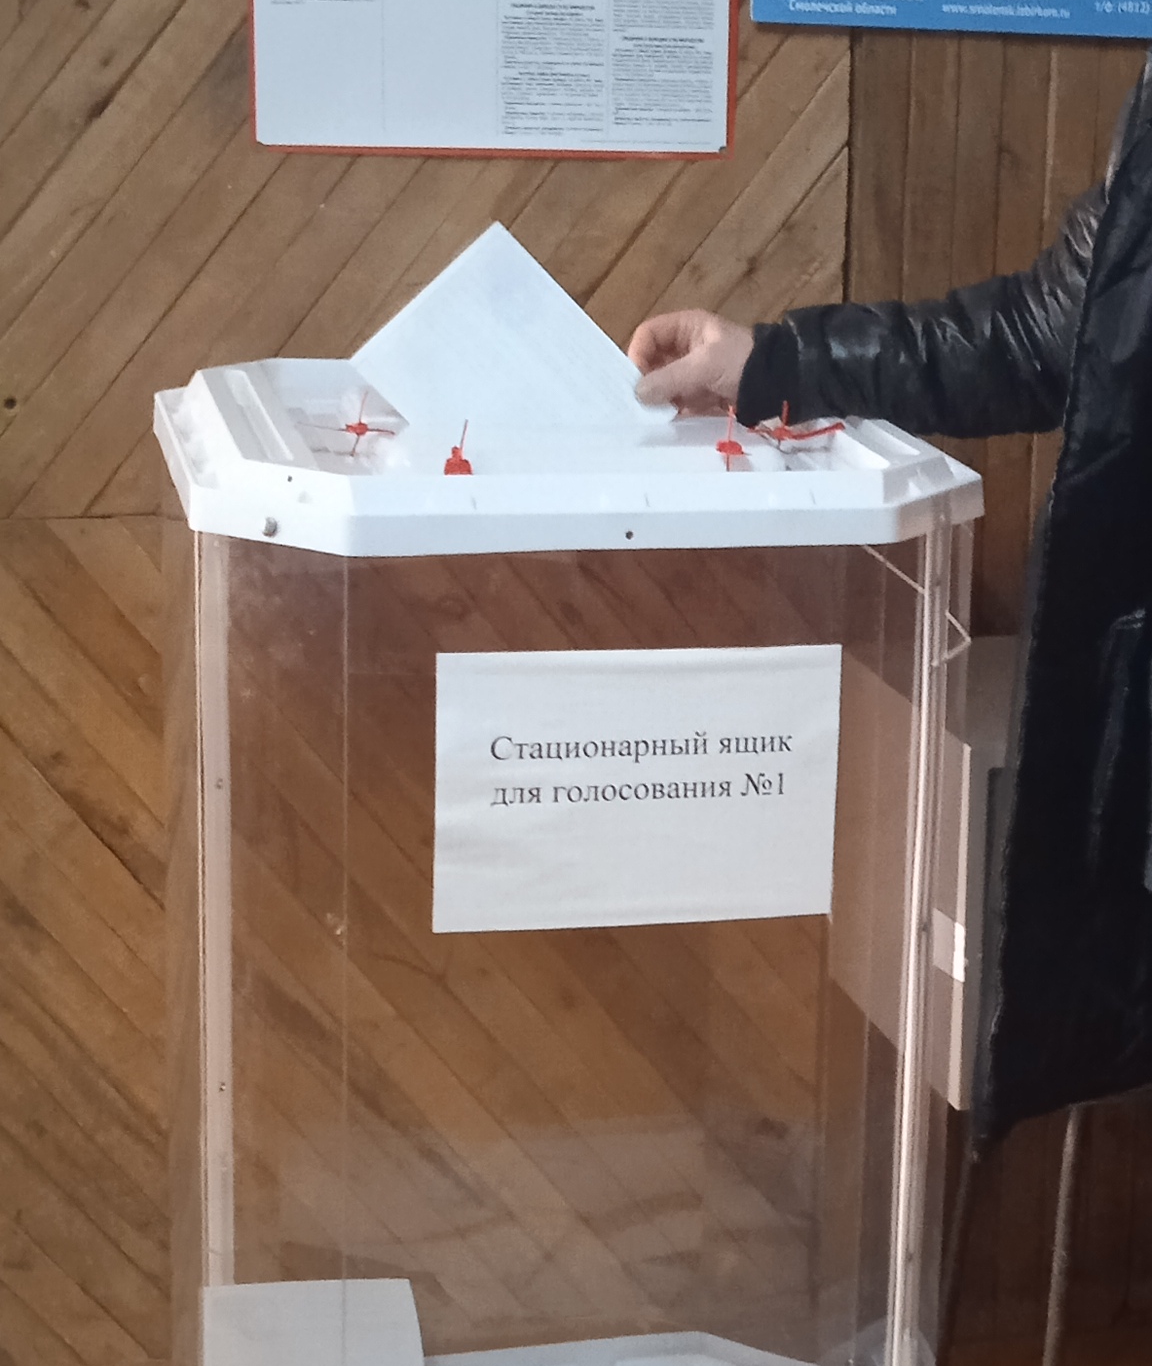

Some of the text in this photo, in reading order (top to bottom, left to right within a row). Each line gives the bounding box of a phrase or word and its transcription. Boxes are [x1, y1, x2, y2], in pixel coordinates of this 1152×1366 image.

[855, 2, 898, 16] области
[490, 731, 793, 764] Стационарный ящик
[490, 771, 785, 808] для голосования №1
